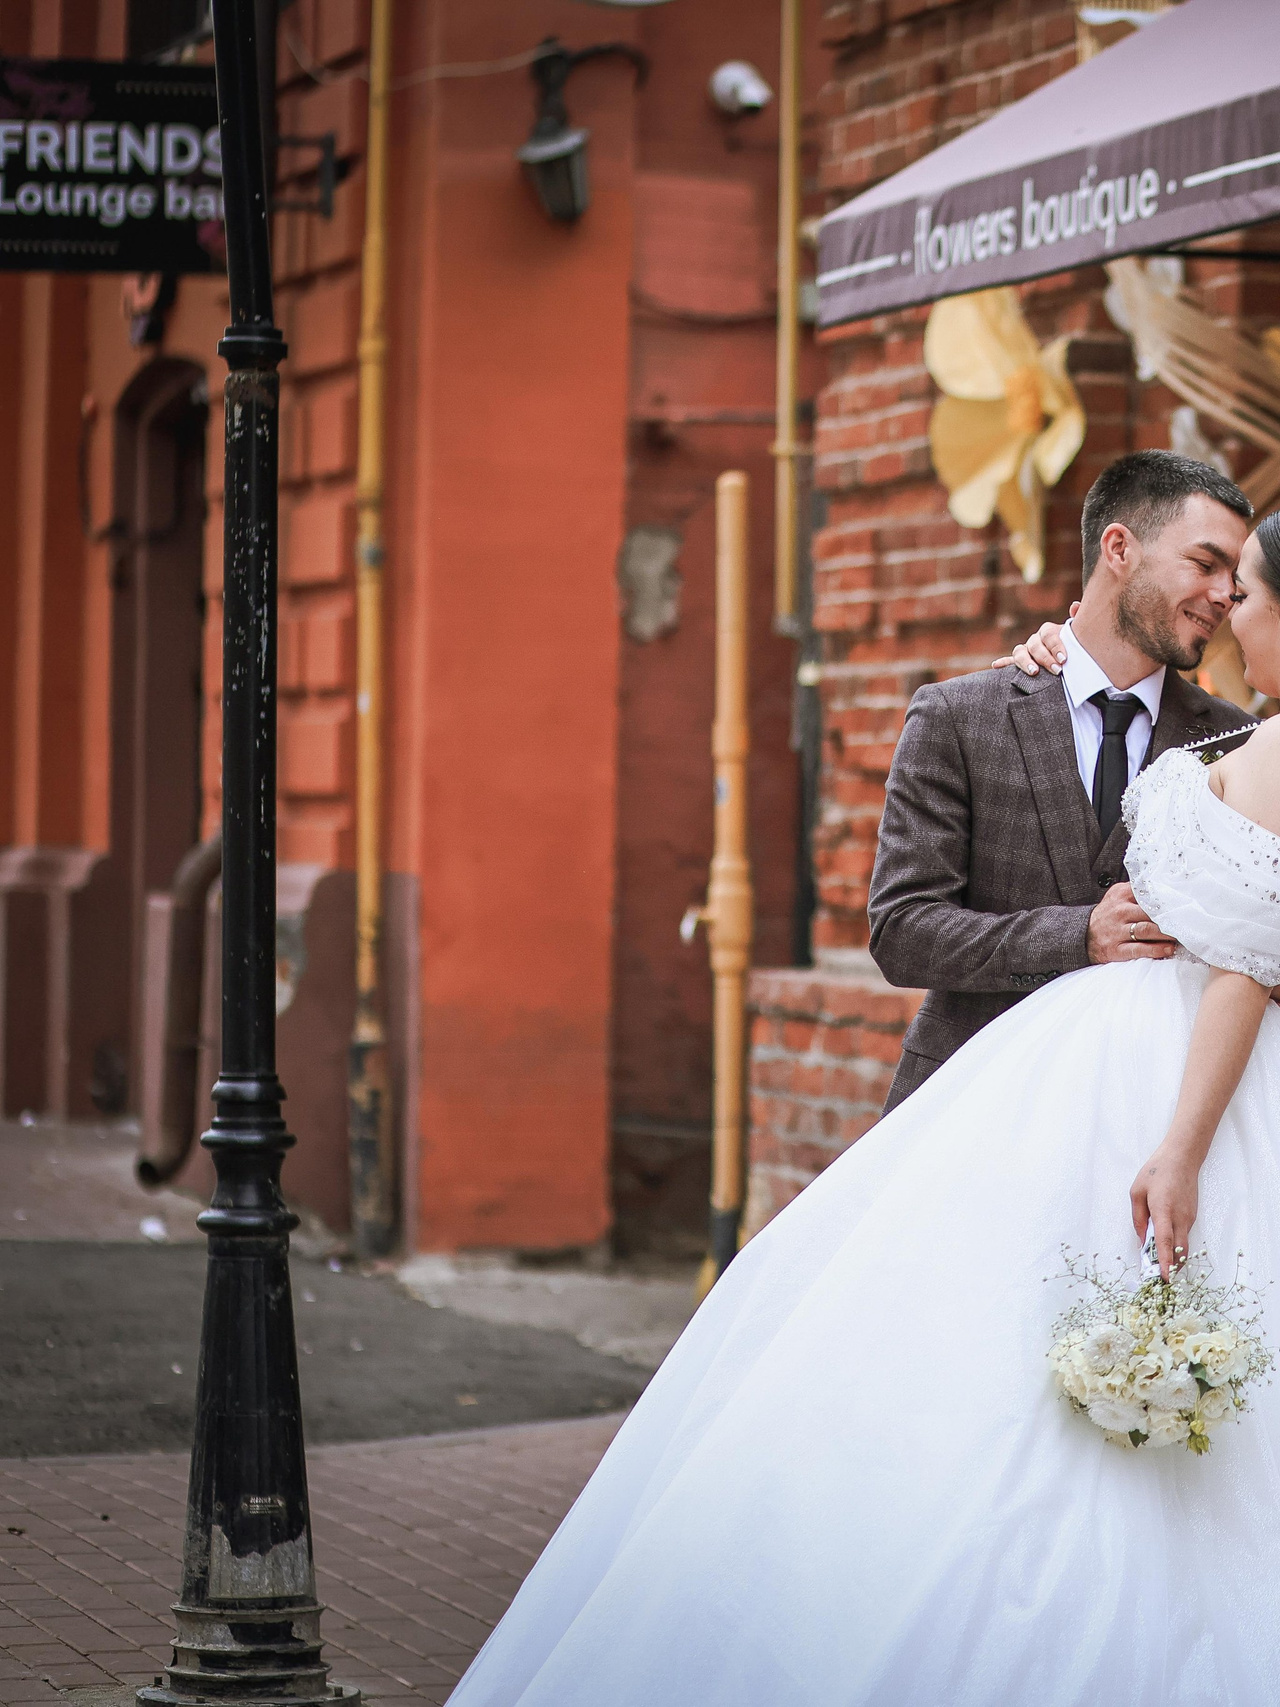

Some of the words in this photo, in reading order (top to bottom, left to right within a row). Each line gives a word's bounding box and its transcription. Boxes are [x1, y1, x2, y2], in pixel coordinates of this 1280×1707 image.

[0, 174, 156, 227] Lounge
[914, 205, 1017, 276] flowers
[1022, 164, 1160, 249] boutique
